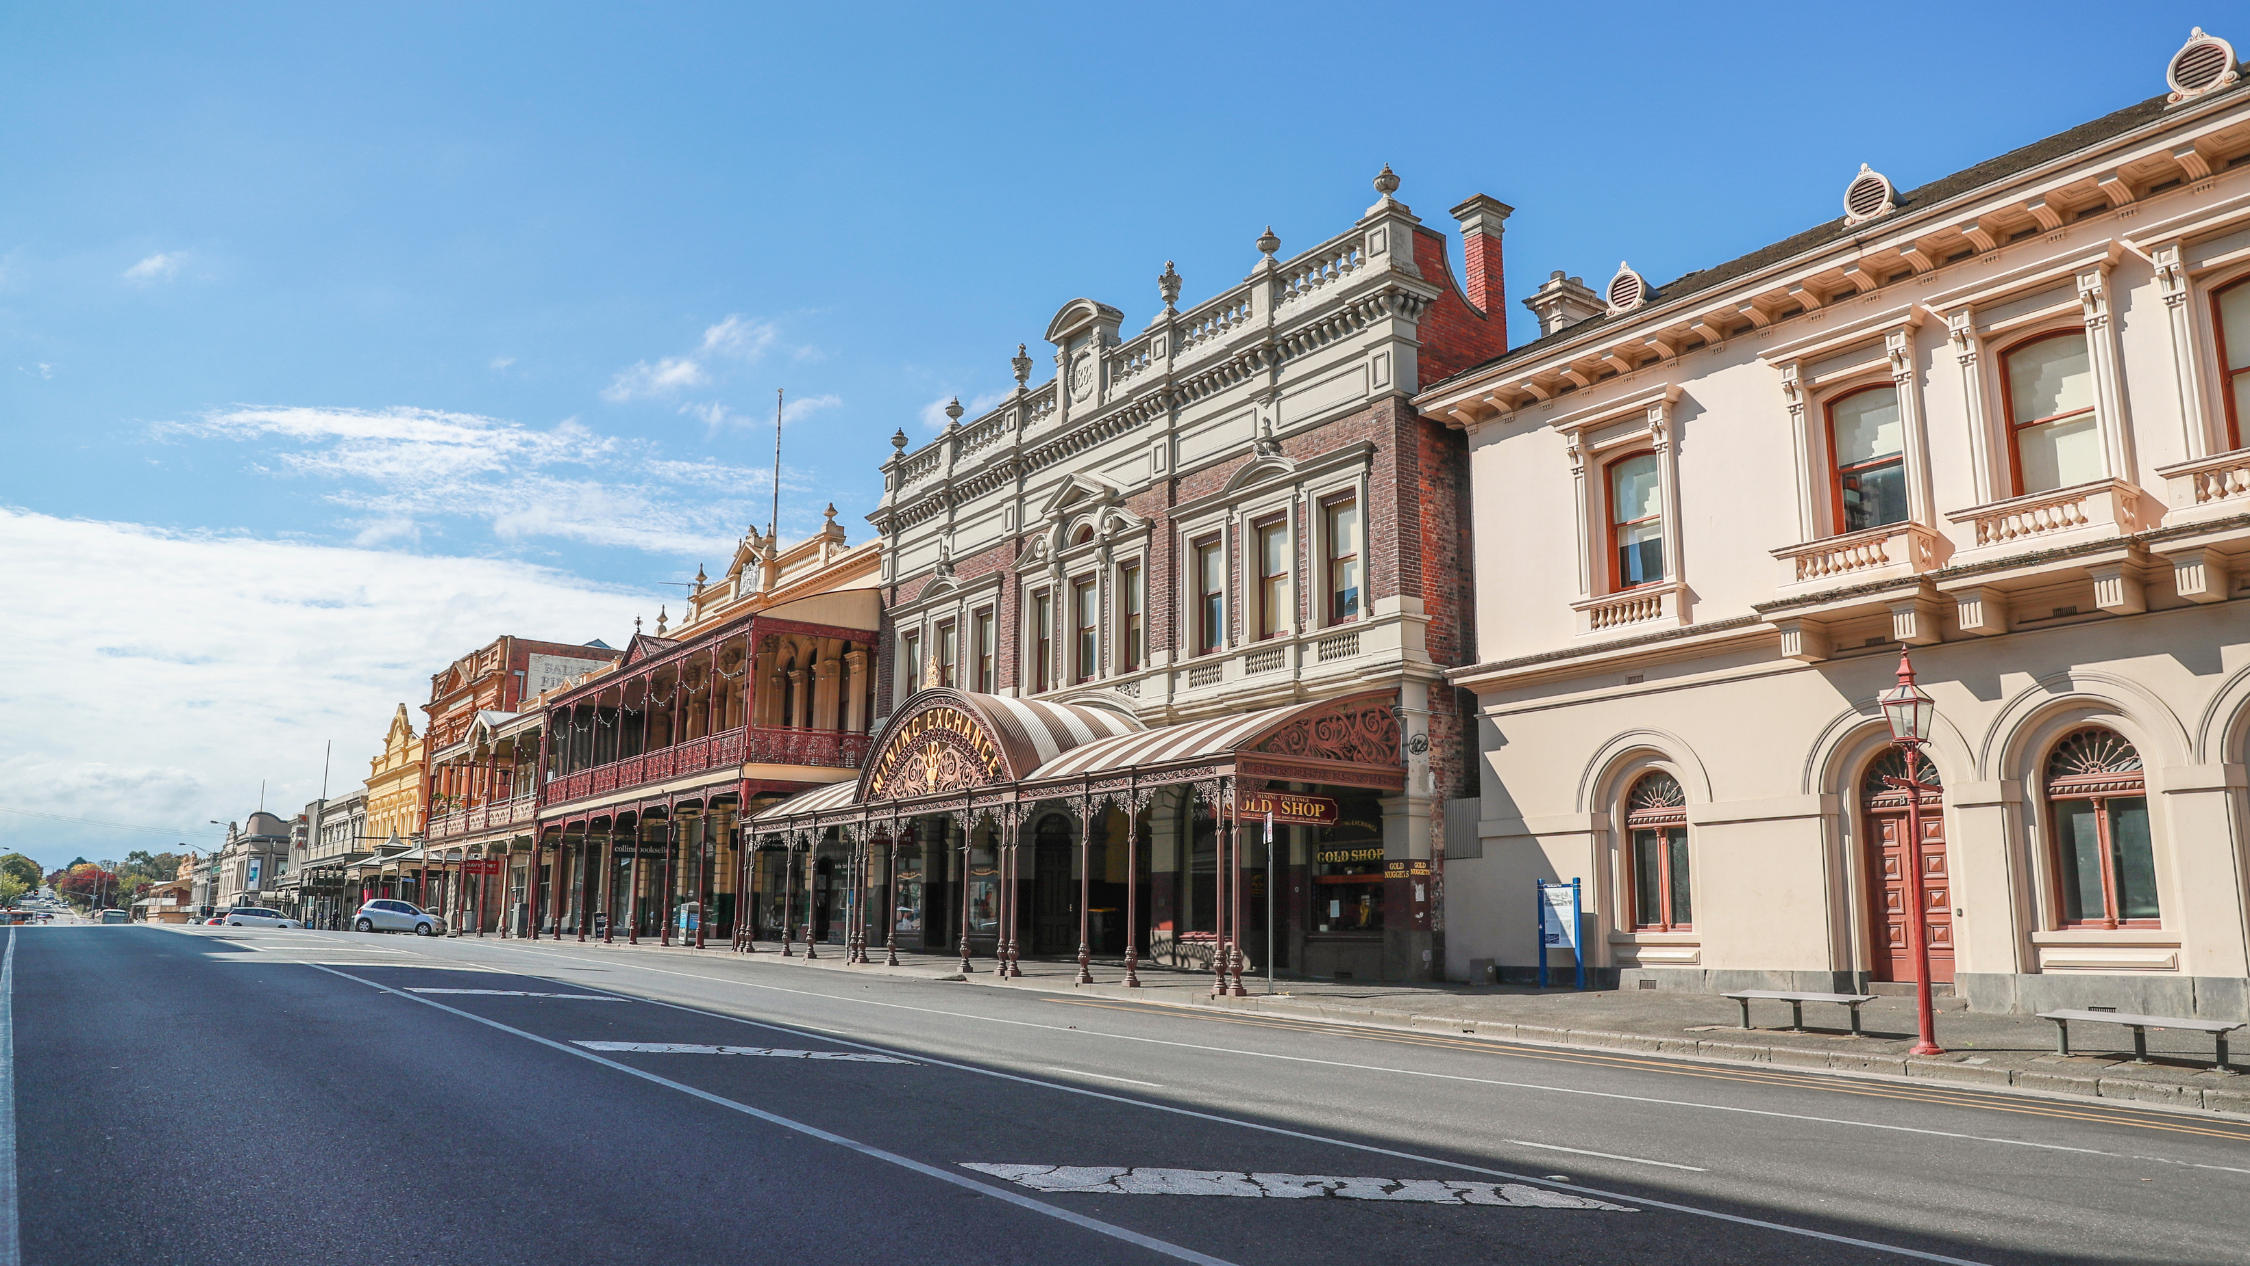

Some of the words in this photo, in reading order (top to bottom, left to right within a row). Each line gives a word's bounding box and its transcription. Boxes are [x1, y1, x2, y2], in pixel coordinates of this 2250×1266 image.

[872, 717, 920, 794] MINING
[927, 708, 1000, 777] EXCHANGE
[1258, 793, 1278, 801] MINING
[1281, 795, 1310, 803] EXCHANGE
[1281, 800, 1326, 817] SHOP
[614, 844, 637, 853] collins
[639, 845, 676, 854] ooksells
[1317, 850, 1350, 863] GOLD
[1351, 848, 1384, 862] SHOP
[1389, 862, 1404, 870] GOLD
[1414, 861, 1427, 869] GOLD
[1384, 870, 1410, 878] NUGGETS
[1410, 868, 1431, 876] NUGGETS
